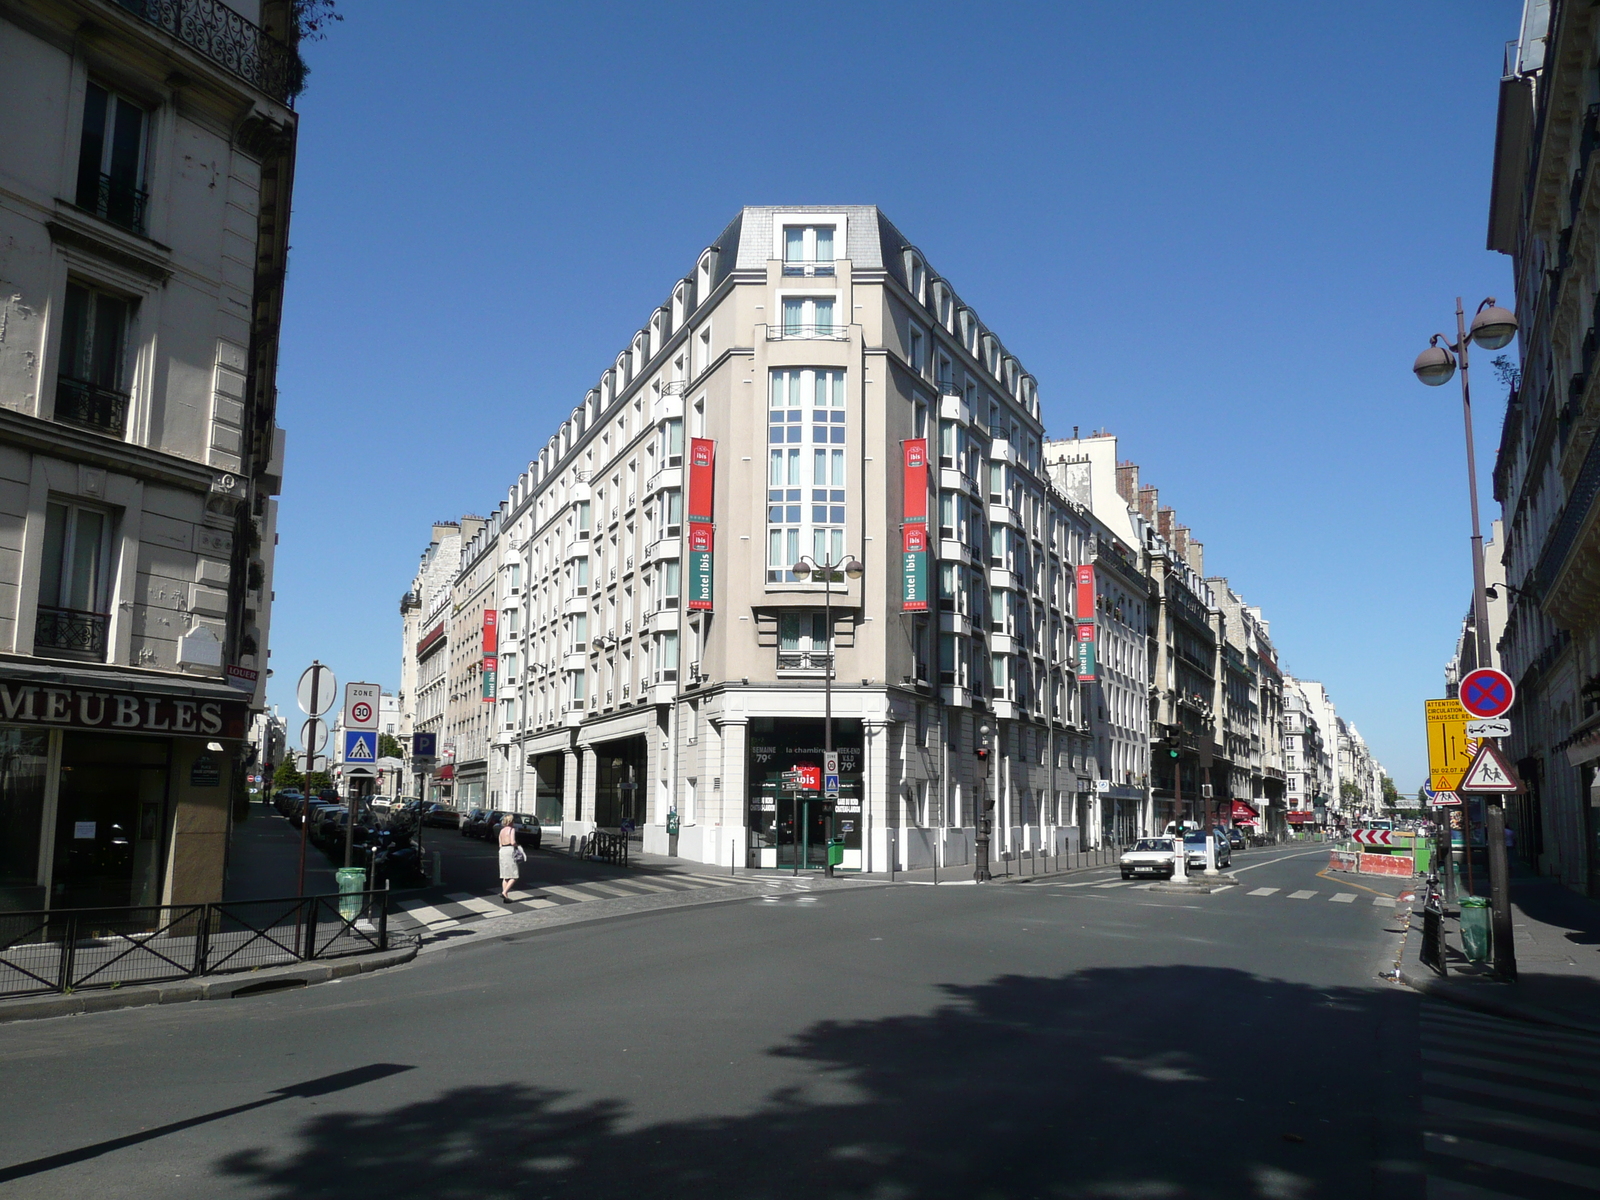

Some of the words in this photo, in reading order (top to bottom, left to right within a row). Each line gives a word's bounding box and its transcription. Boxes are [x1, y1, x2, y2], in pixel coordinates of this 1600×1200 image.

[700, 554, 709, 571] ibis
[906, 554, 916, 572] ibis
[700, 574, 709, 599] hotel
[906, 575, 916, 600] hotel
[229, 666, 256, 680] LOUER
[0, 684, 223, 734] MEUBLES
[356, 708, 368, 717] 30
[420, 738, 430, 751] P
